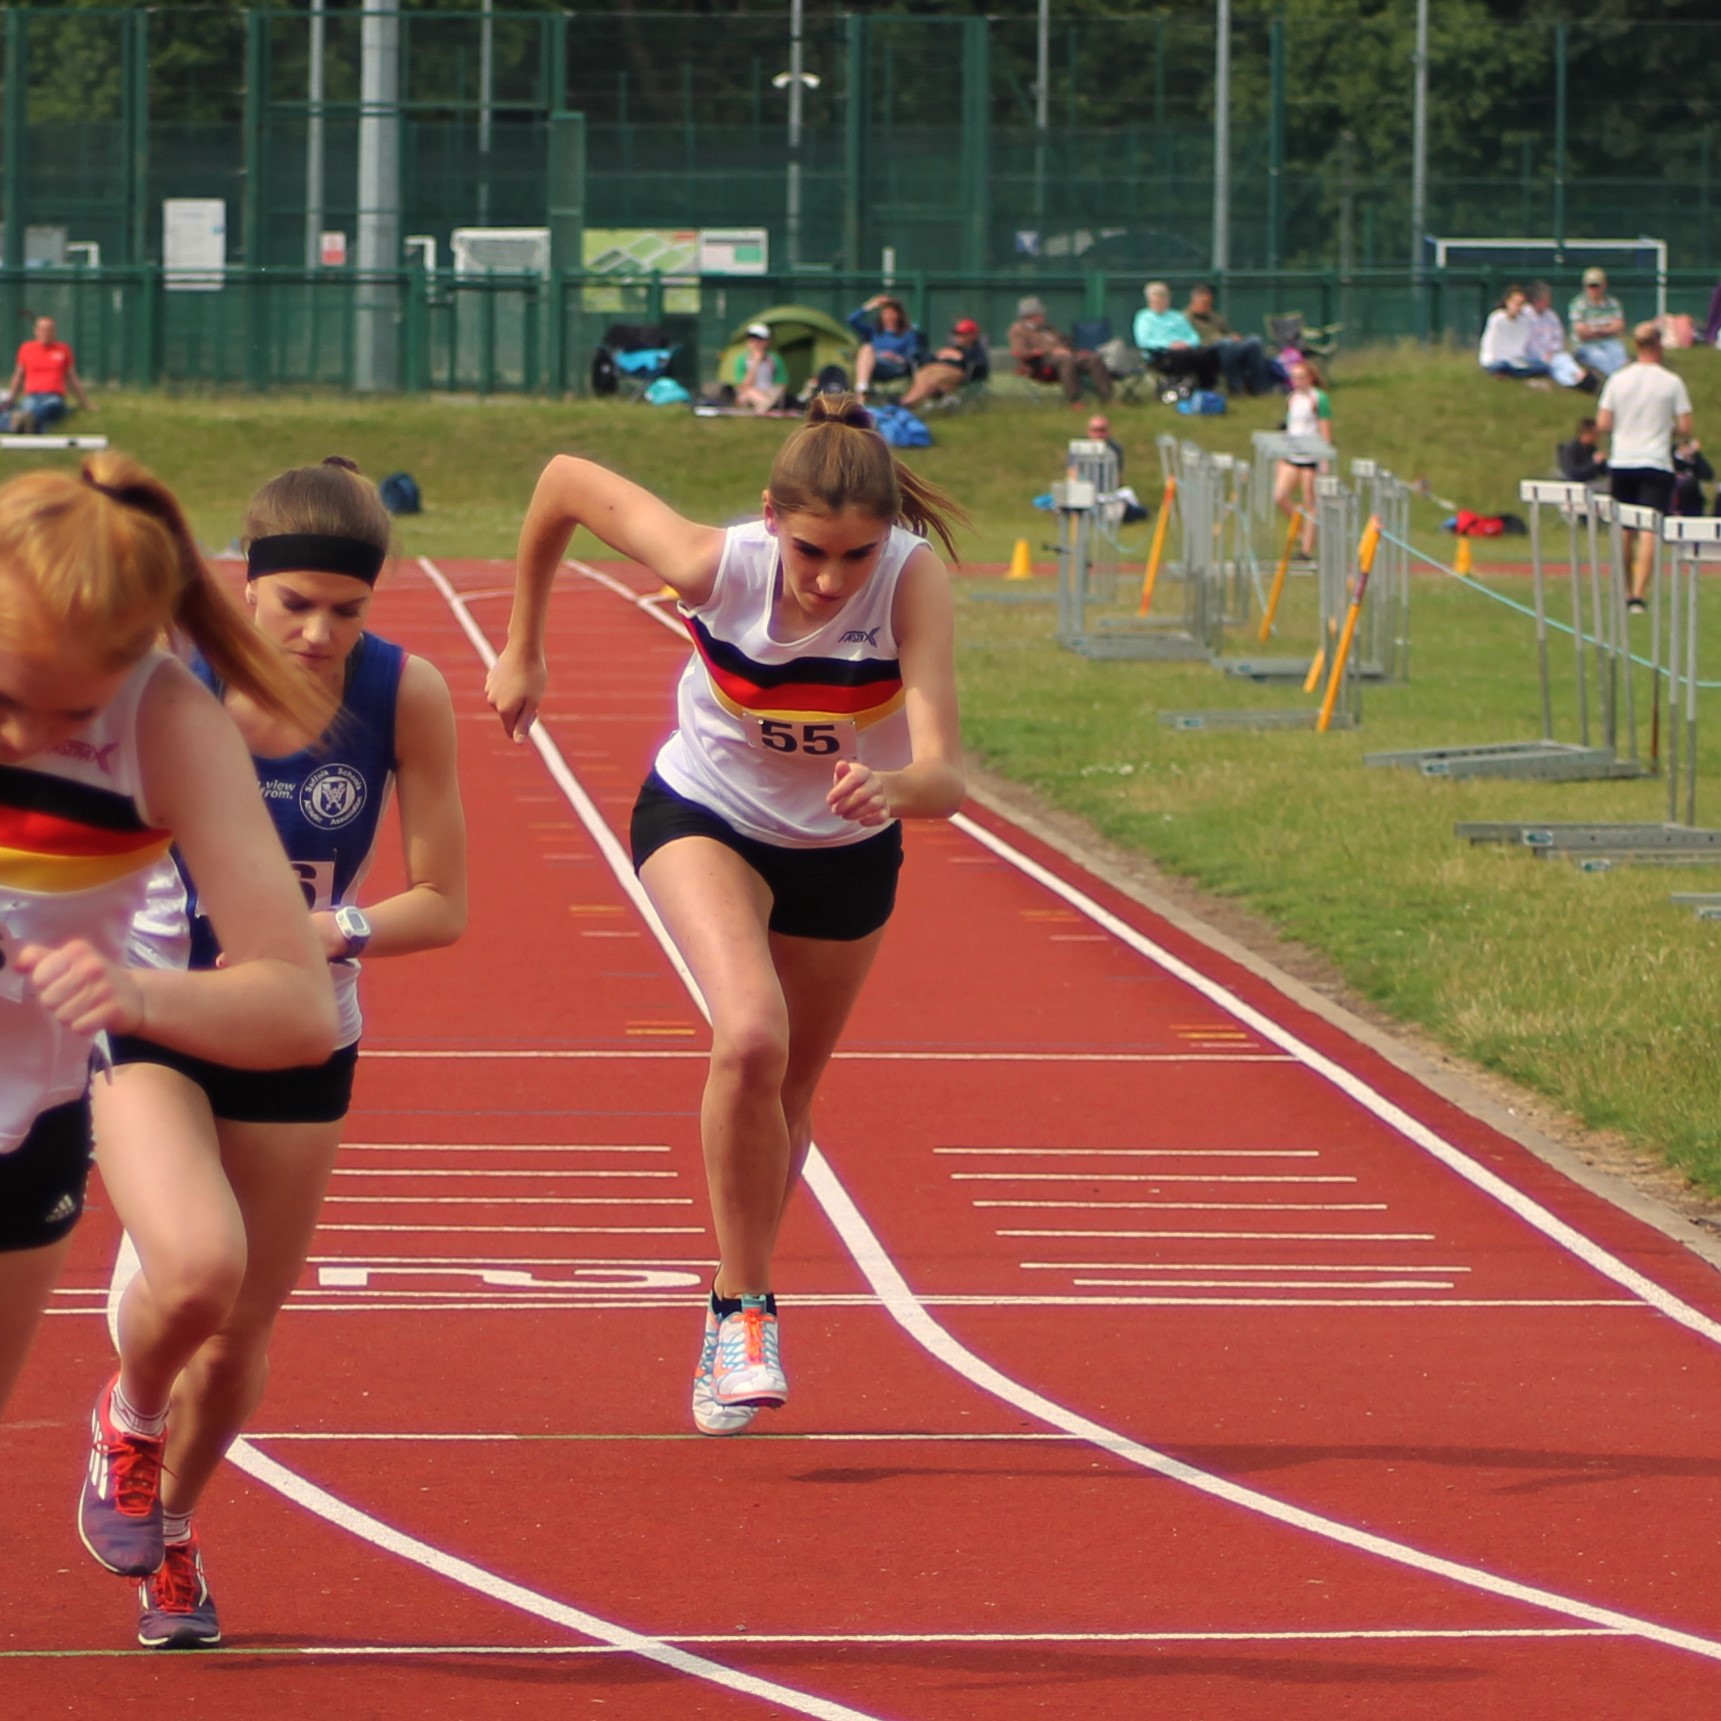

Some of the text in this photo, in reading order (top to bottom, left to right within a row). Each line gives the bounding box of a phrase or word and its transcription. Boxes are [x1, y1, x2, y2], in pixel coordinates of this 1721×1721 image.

[761, 720, 840, 755] 55
[266, 779, 296, 792] view
[305, 768, 362, 793] Suffolk Schools
